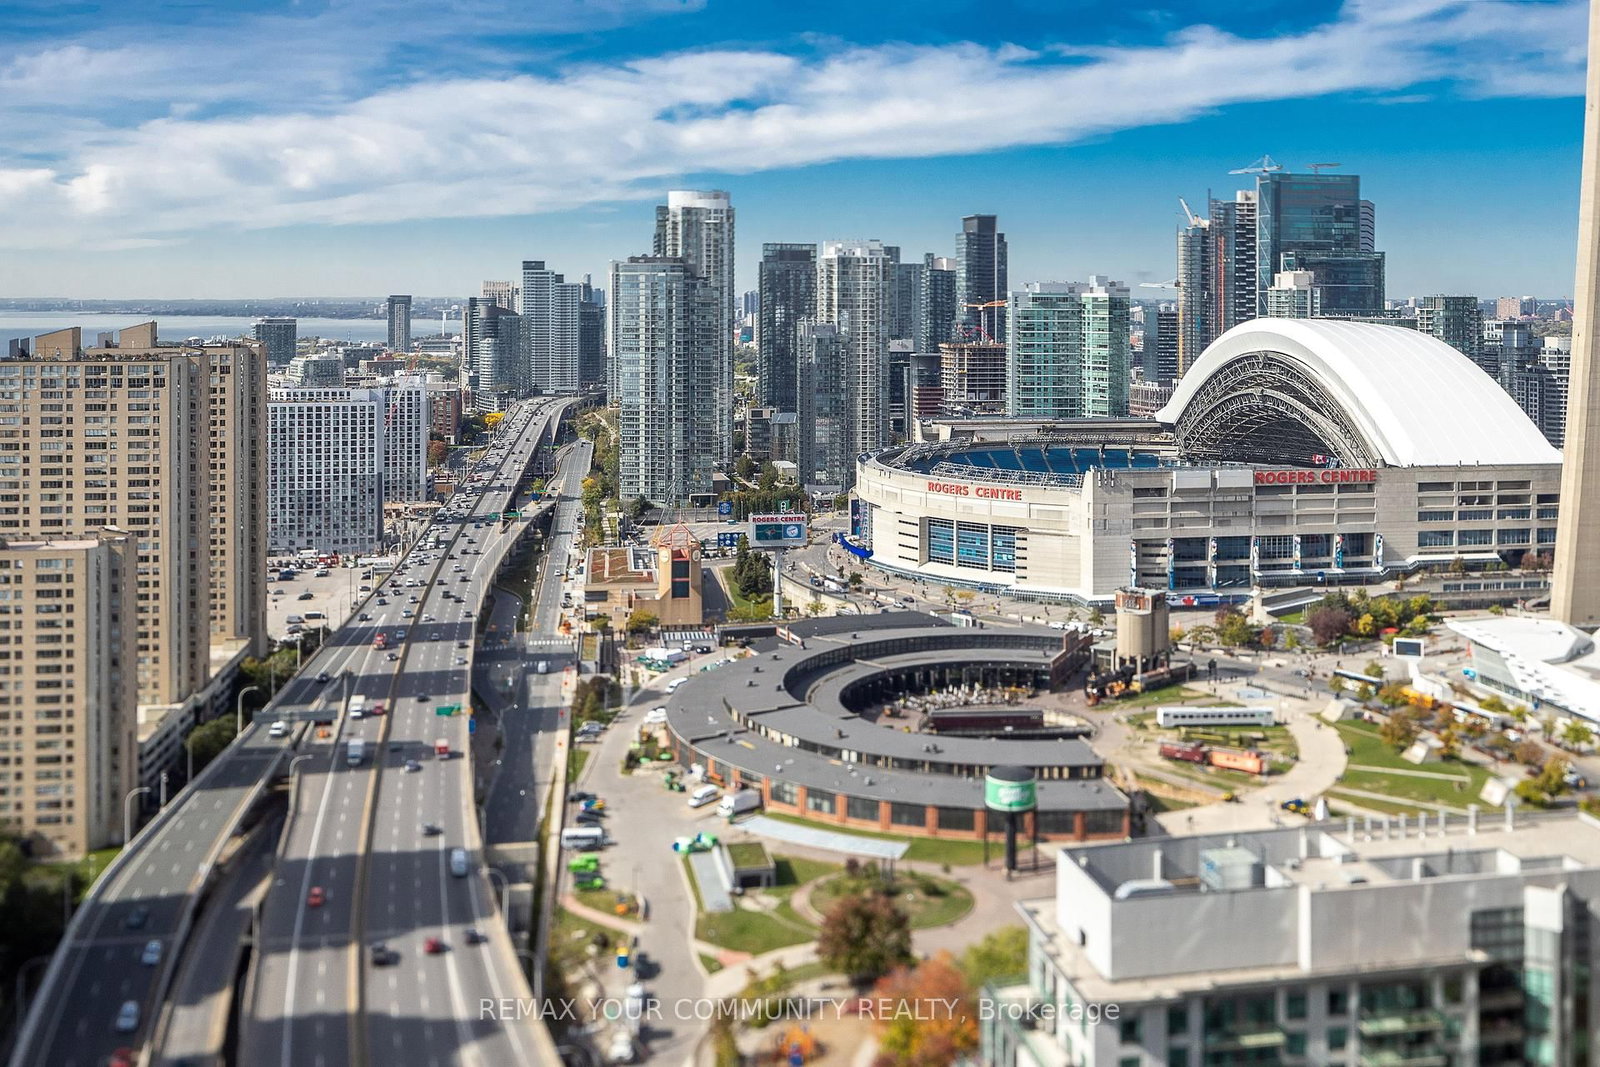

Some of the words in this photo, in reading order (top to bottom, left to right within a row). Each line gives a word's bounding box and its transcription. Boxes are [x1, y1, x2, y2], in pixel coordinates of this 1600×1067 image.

[1254, 470, 1316, 484] ROGERS
[1320, 469, 1377, 483] CENTRE
[928, 481, 969, 496] ROGERS
[975, 487, 1022, 501] CENTRE
